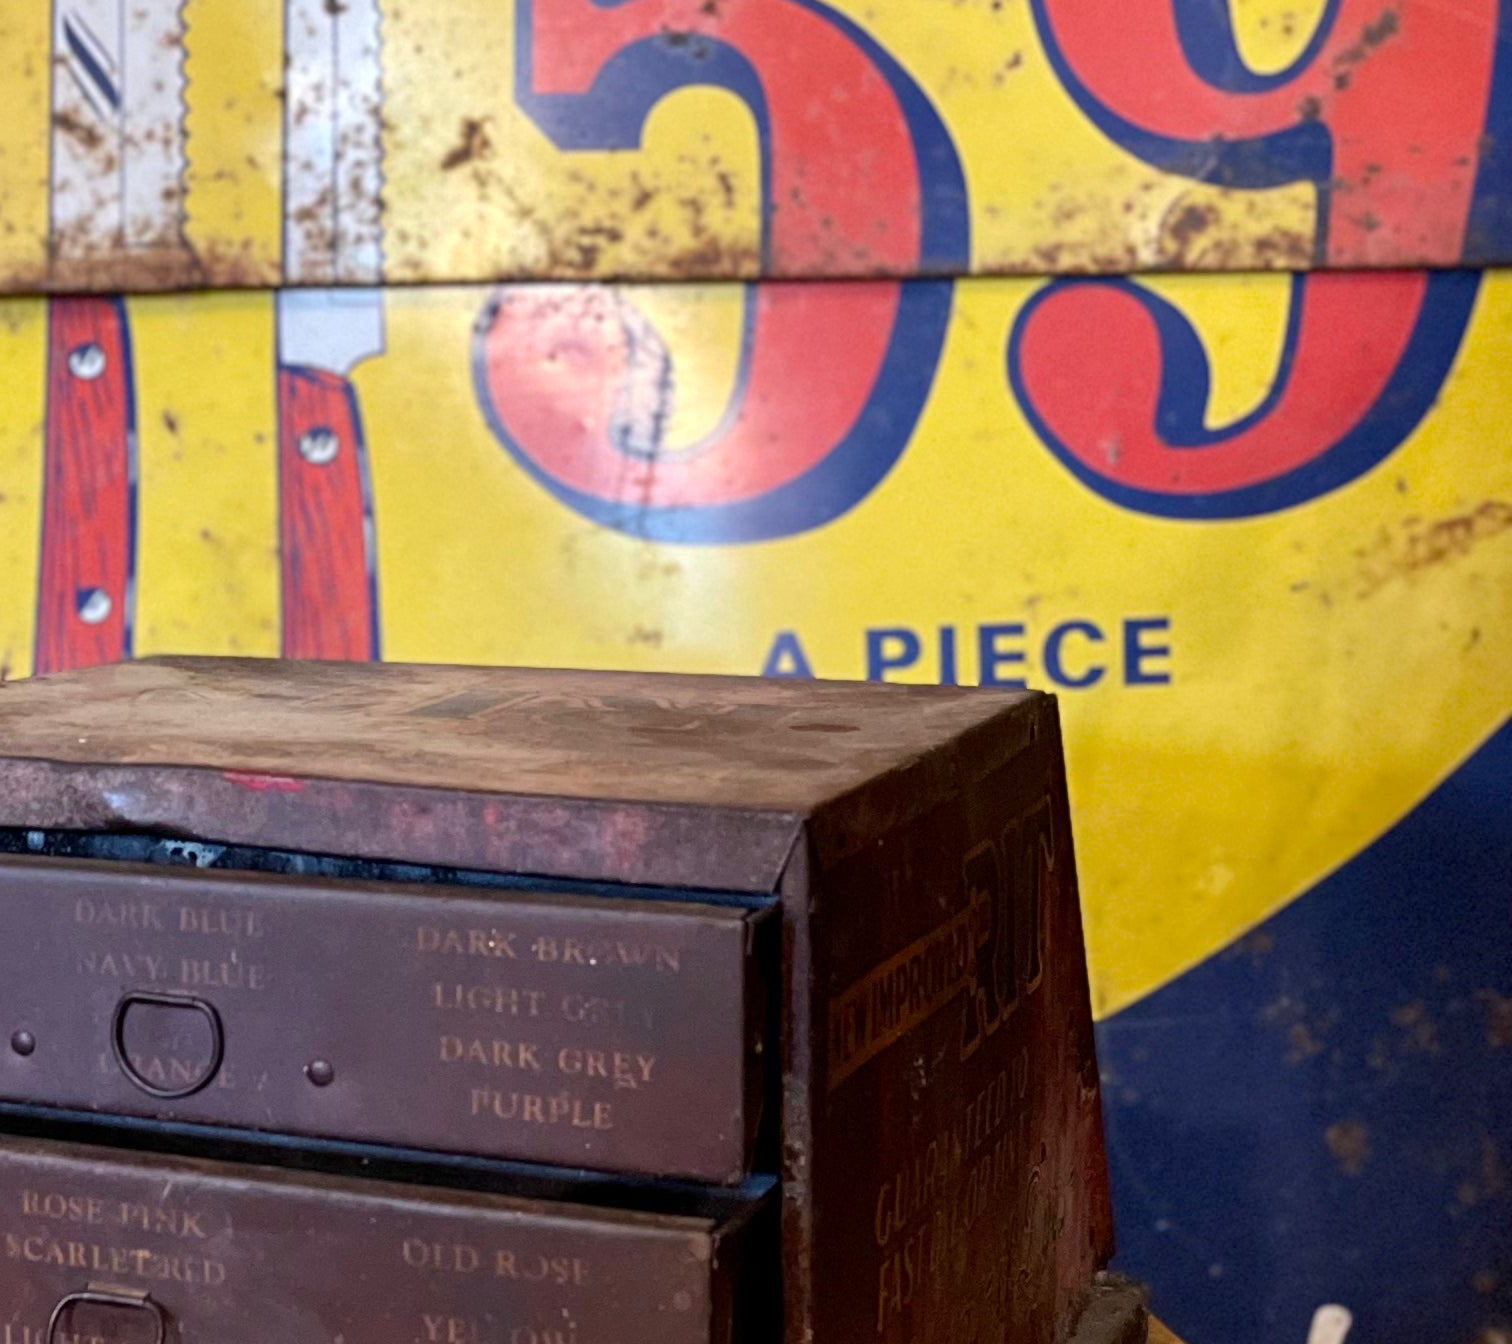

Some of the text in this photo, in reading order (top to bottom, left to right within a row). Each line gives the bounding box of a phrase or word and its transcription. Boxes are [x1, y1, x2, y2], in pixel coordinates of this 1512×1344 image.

[760, 617, 1171, 689] A PIECE
[74, 898, 265, 938] DARK BLUE
[415, 925, 516, 957] DARK
[76, 950, 265, 991] NAVY BLUE
[434, 981, 543, 1016] LIGHT
[440, 1036, 657, 1083] DARK GREY
[469, 1087, 615, 1130] PURPLE
[22, 1189, 207, 1239] ROSE PINK
[6, 1232, 151, 1276] SCARLET
[402, 1239, 587, 1286] OLD ROSE
